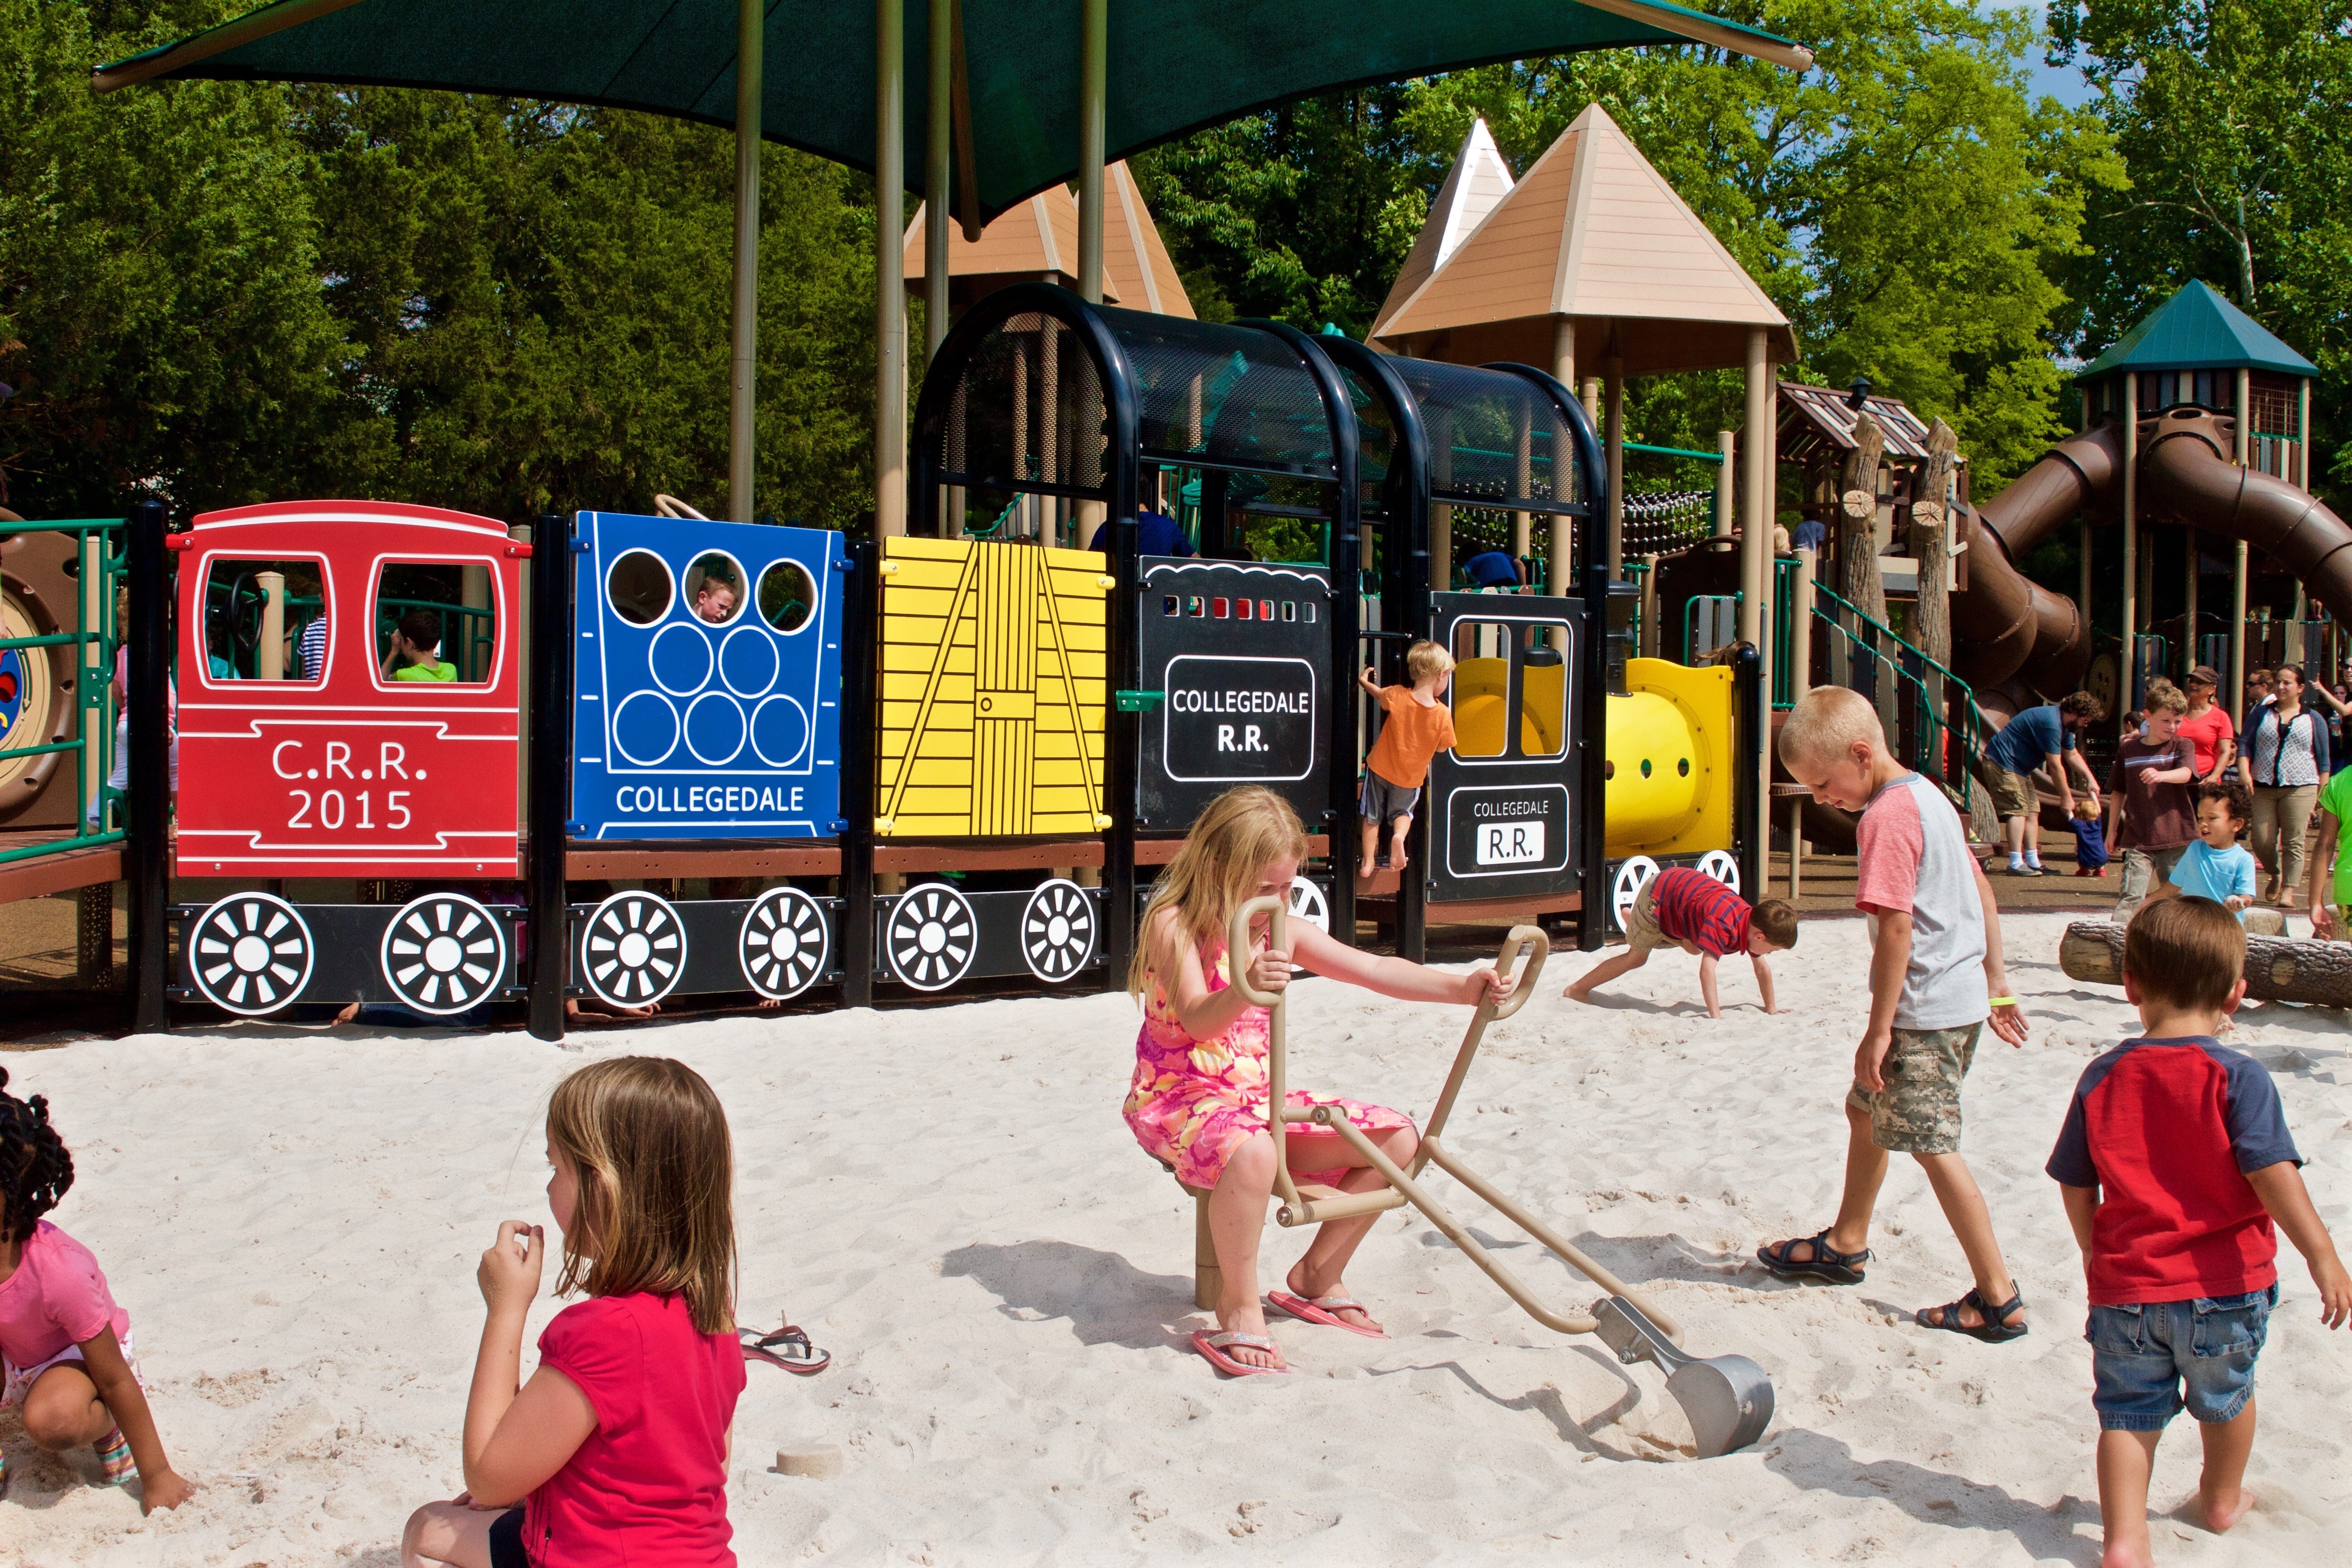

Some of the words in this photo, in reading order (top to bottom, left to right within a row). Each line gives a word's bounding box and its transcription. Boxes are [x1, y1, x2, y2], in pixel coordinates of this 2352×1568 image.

[1173, 690, 1308, 713] COLLEGEDALE
[1218, 725, 1269, 752] R.R.
[272, 740, 427, 779] C.R.R.
[288, 789, 411, 829] 2015
[616, 786, 804, 812] COLLEGEDALE
[1474, 800, 1548, 817] COLLEGEDALE
[1490, 828, 1533, 858] R.R.
